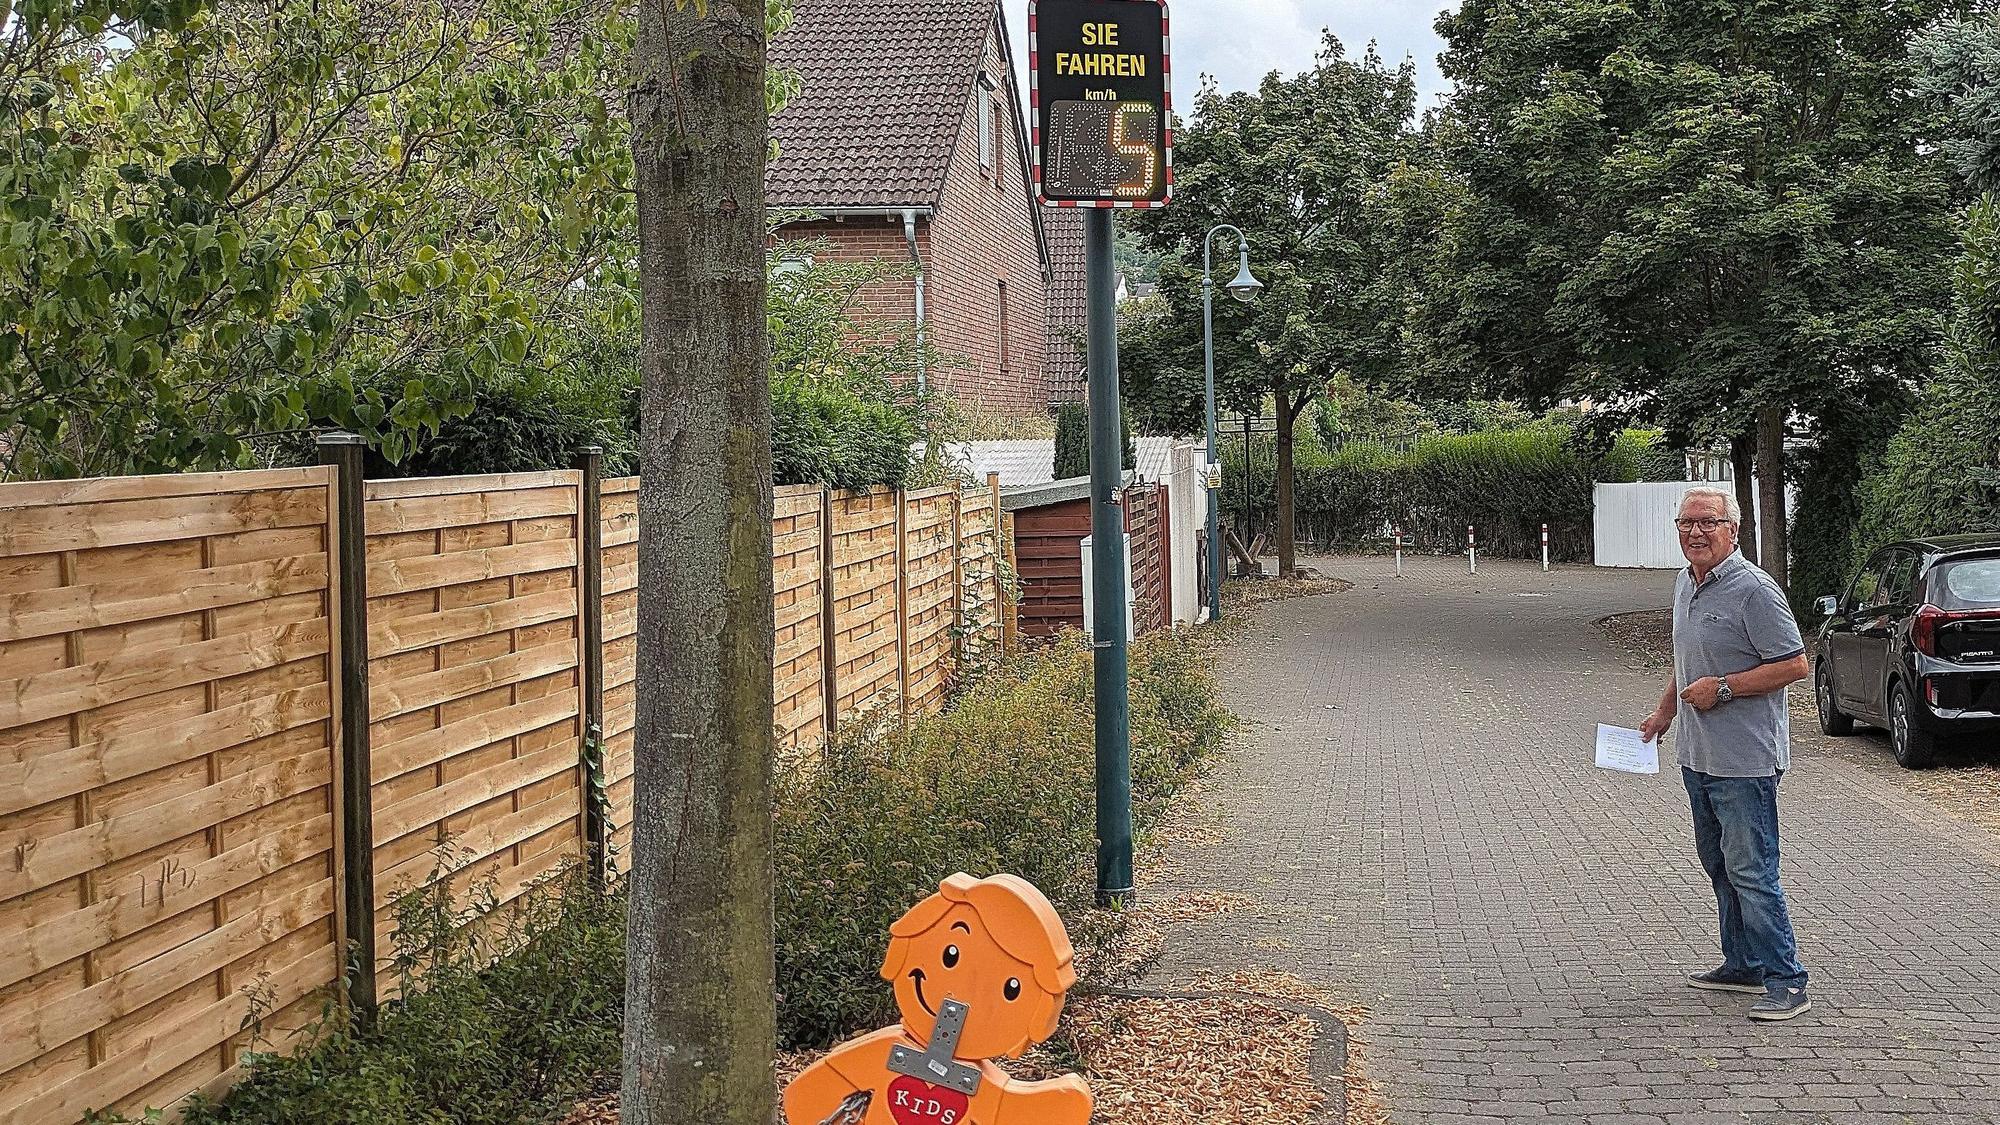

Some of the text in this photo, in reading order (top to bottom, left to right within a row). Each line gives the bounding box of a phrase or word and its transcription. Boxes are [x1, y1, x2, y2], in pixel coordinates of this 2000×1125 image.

[1081, 22, 1119, 46] SIE
[1055, 52, 1145, 77] FAHREN
[1085, 88, 1117, 101] km/h
[895, 1089, 956, 1125] KIDS
